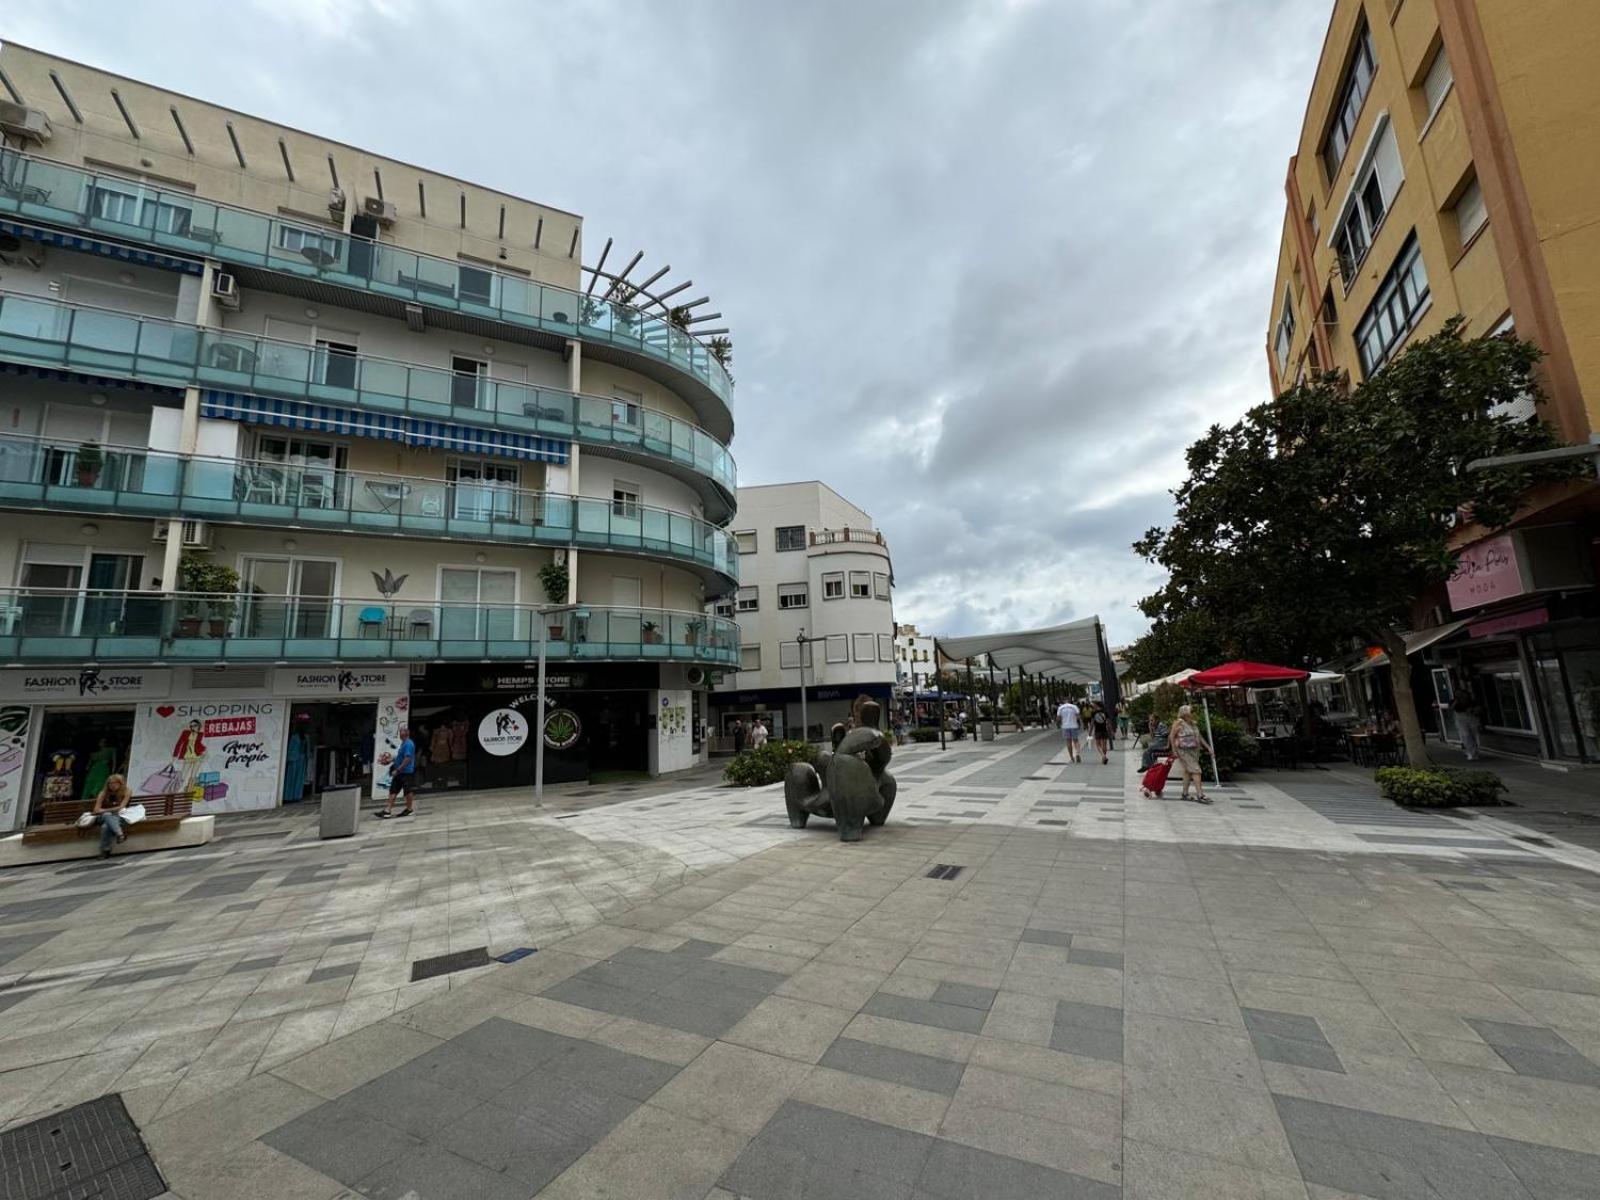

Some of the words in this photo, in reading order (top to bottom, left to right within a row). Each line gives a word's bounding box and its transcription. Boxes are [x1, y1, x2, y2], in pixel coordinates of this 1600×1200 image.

[24, 677, 76, 687] FASHION
[108, 676, 143, 686] STORE
[297, 674, 336, 683] FASHION
[360, 674, 387, 682] STORE
[509, 693, 557, 708] WELCME
[177, 703, 273, 717] SHOPPING
[208, 720, 253, 734] REBAJAS
[222, 740, 263, 754] Amor
[225, 752, 270, 769] propio
